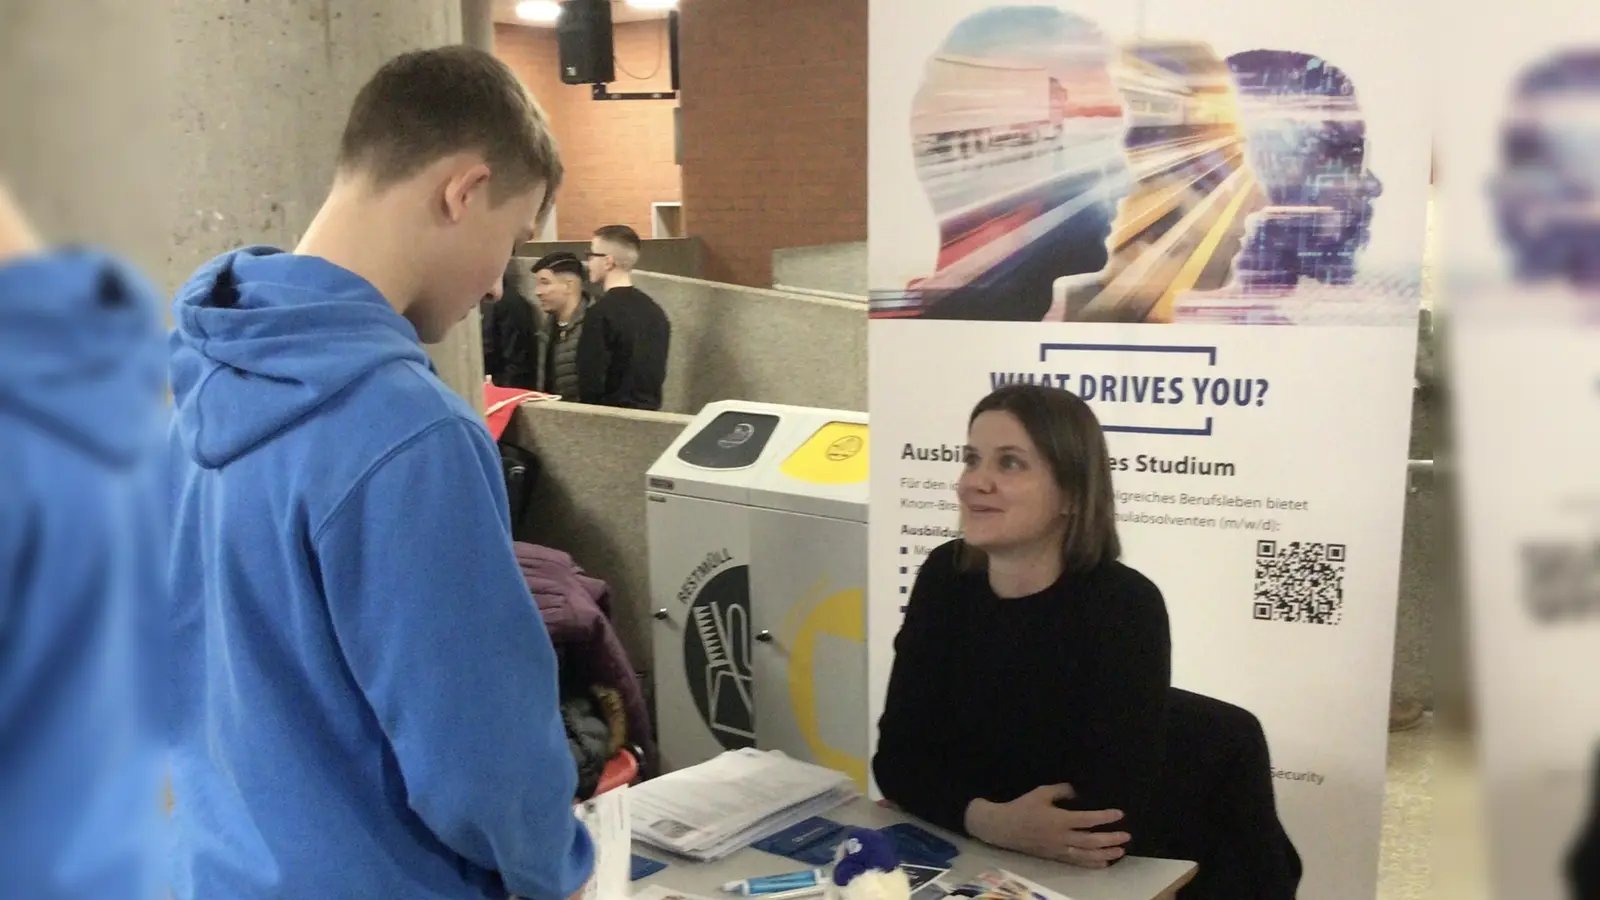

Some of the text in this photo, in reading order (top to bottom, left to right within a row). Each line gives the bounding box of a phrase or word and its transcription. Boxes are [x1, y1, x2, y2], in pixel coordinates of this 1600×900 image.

[1079, 374, 1183, 405] DRIVES
[1192, 377, 1269, 407] YOU?
[1135, 454, 1236, 477] Studium
[900, 477, 921, 489] Für
[922, 478, 947, 490] den
[1180, 493, 1262, 509] Berufsleben
[1266, 496, 1309, 511] bietet
[1219, 517, 1281, 532] (m/w/d):
[1269, 766, 1325, 786] Security
